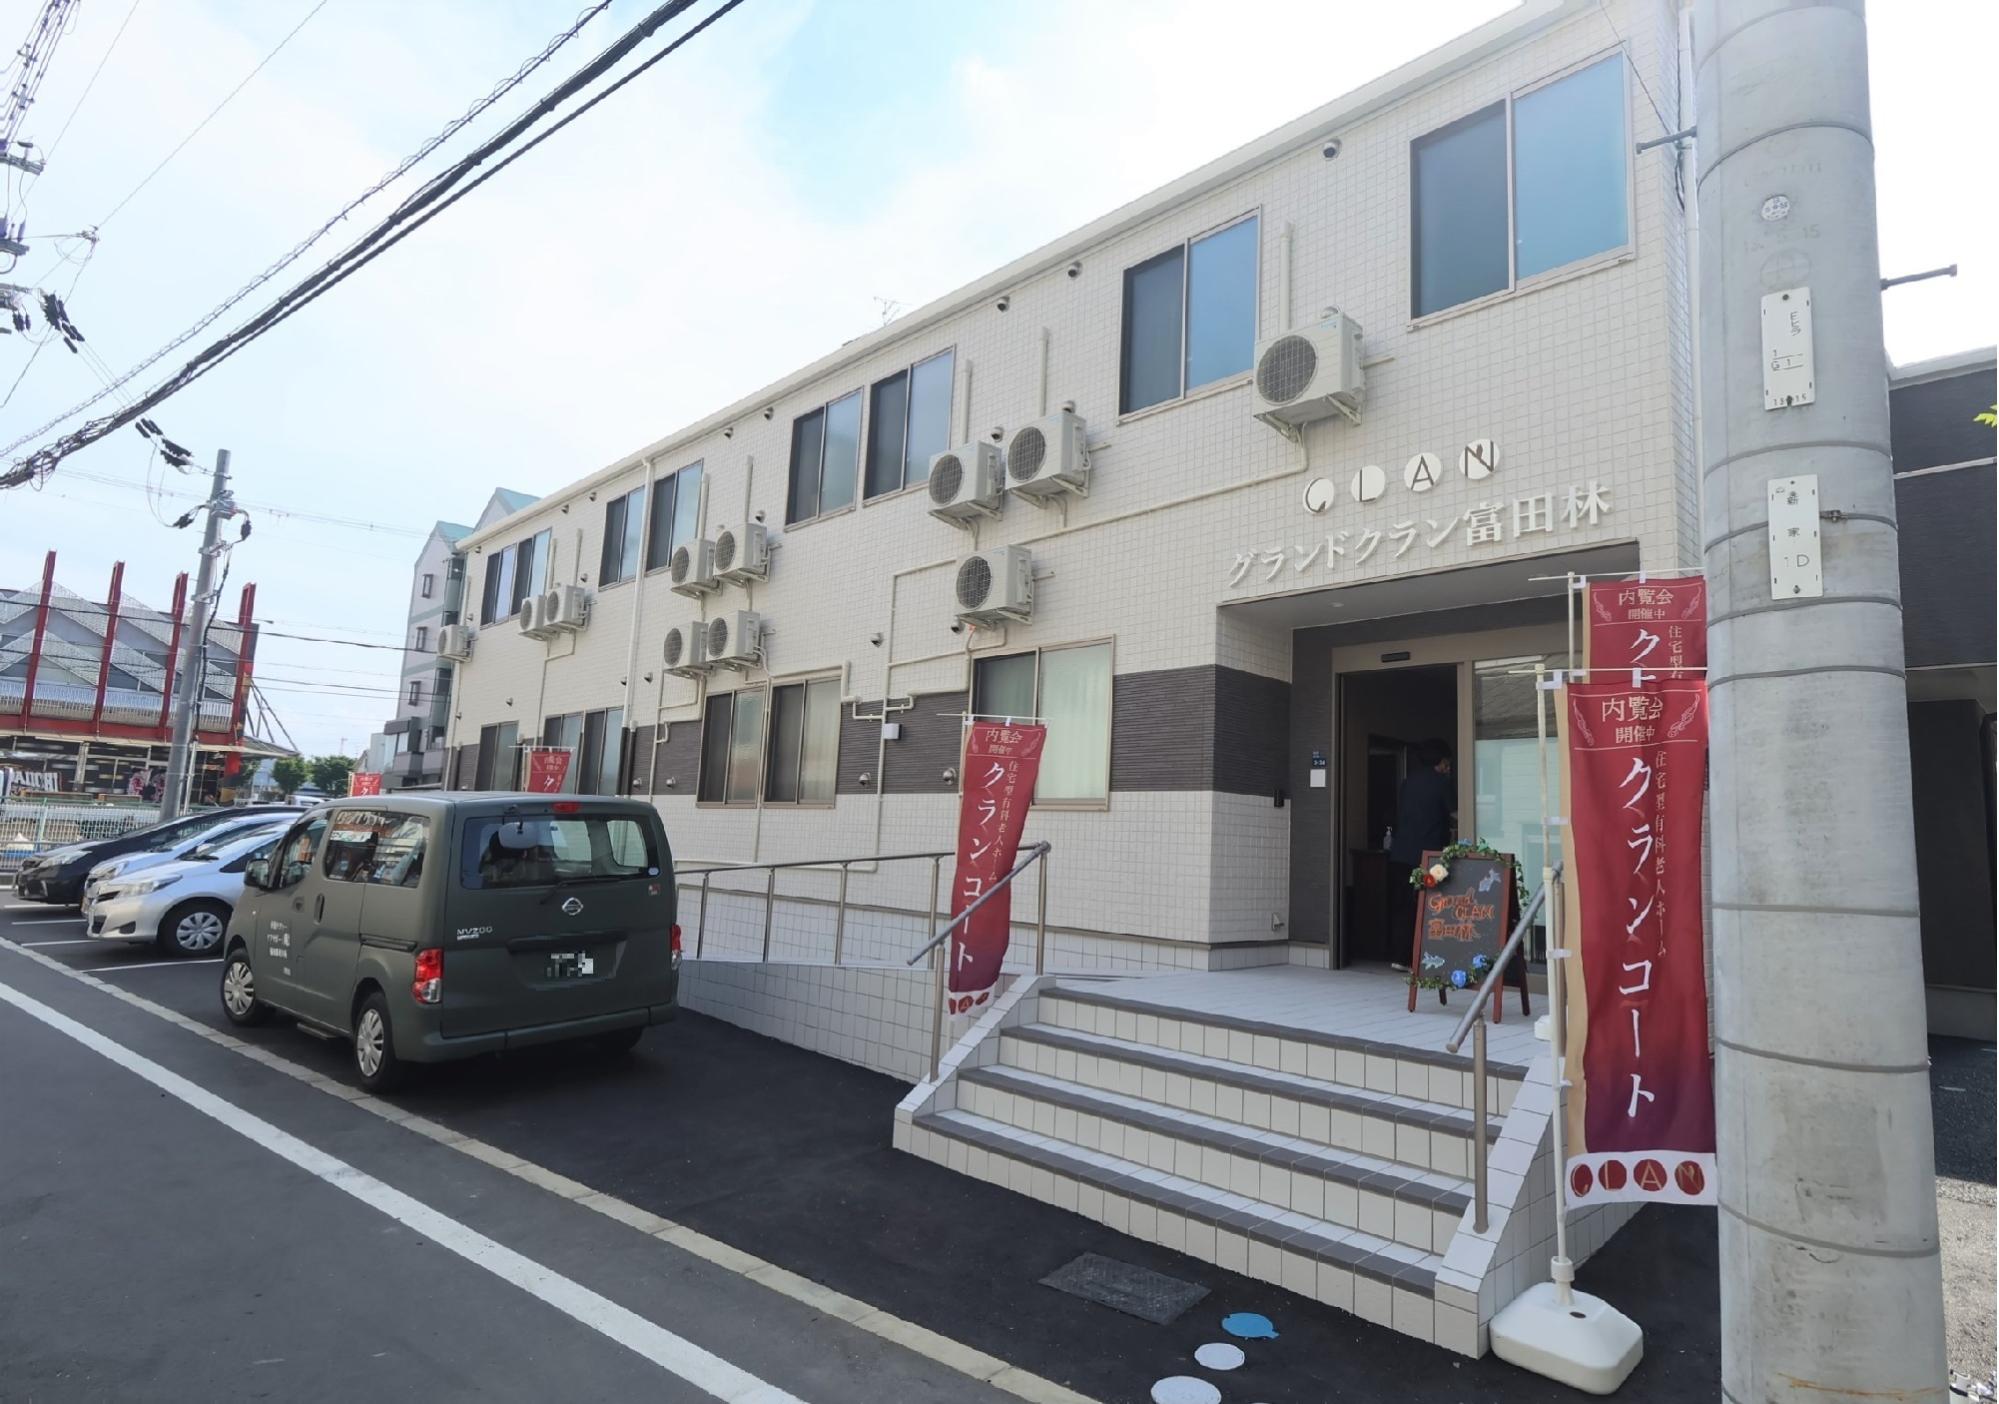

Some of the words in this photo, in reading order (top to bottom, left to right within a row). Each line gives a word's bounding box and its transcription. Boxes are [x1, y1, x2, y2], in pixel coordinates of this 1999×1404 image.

[1303, 438, 1500, 515] CLAN
[1229, 480, 1613, 588] グランドクラン富田林
[1618, 588, 1674, 606] 内覧会
[1628, 608, 1666, 620] 開催中
[1602, 696, 1664, 722] 内覧会
[985, 729, 1023, 744] 内覧会
[1615, 725, 1656, 743] 開催中
[958, 762, 1005, 972] クランコート
[1618, 757, 1656, 1118] クランコート
